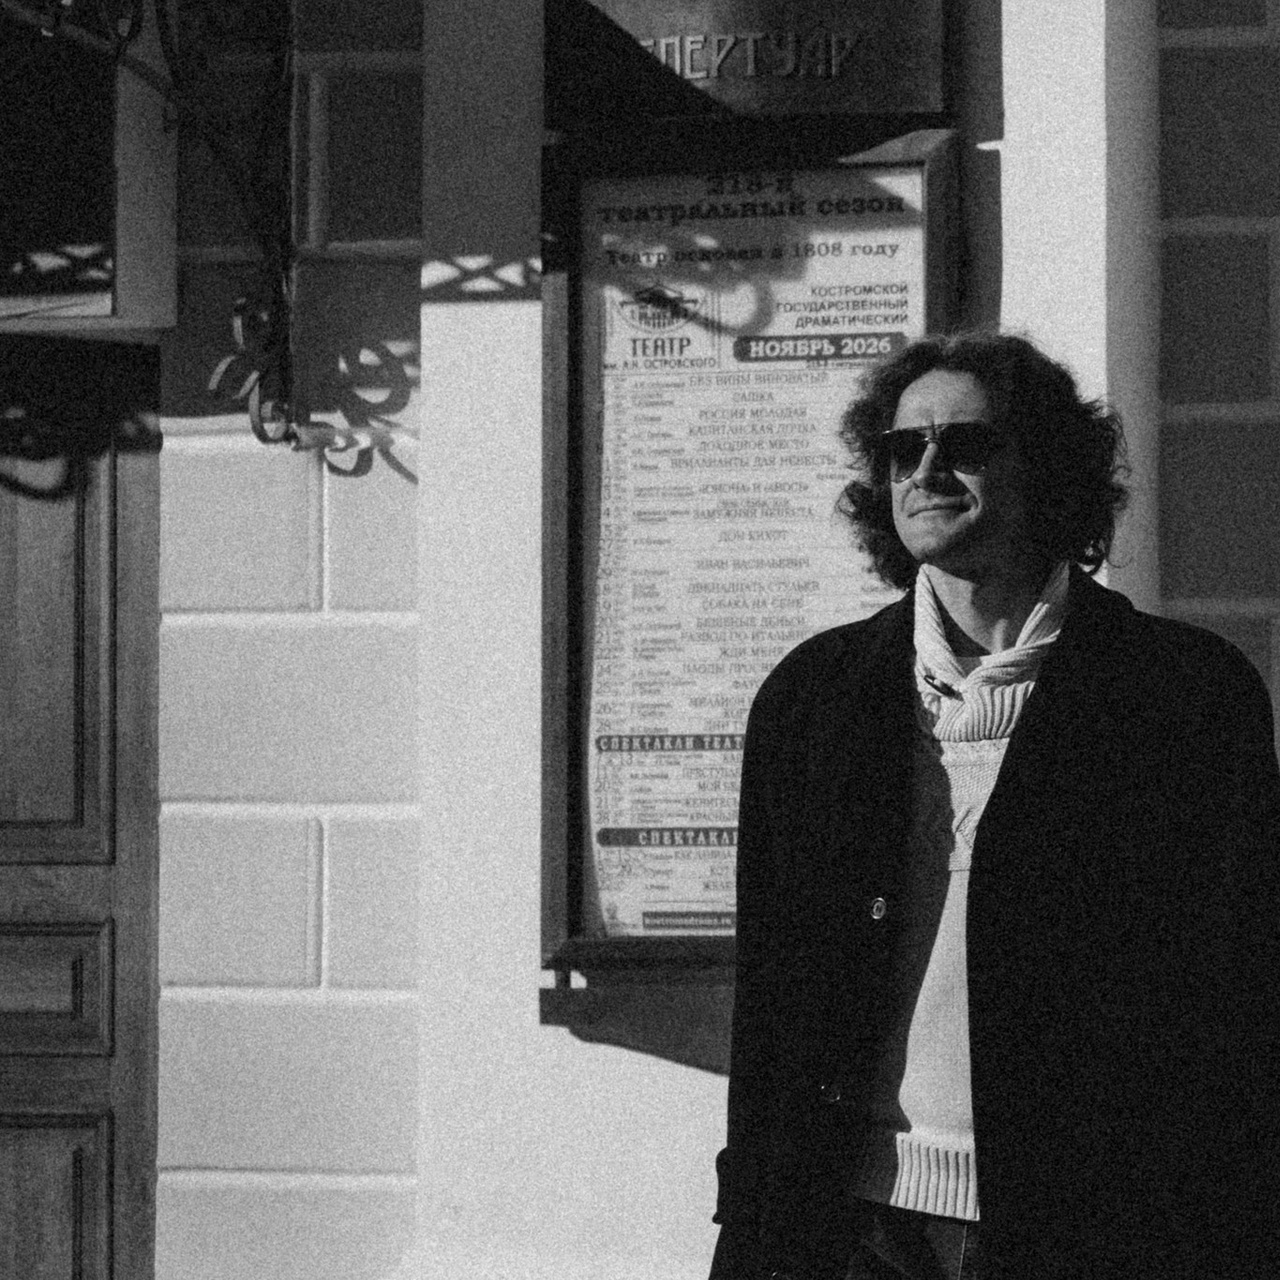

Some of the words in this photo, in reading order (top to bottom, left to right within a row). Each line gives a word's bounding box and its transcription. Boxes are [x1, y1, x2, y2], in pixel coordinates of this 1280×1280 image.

[638, 26, 860, 80] ПЕРТУАР
[817, 197, 905, 216] сезон
[791, 242, 844, 260] 1808
[850, 243, 901, 259] году
[811, 282, 909, 297] КОСТРОМСКОЙ
[776, 296, 909, 314] ГОСУДАРСТВЕННЫЙ
[795, 312, 909, 329] ДРАМАТИЧЕСКИЙ
[630, 336, 692, 357] ТЕАТР
[749, 338, 836, 358] НОЯБРЬ
[841, 337, 892, 354] 2026
[643, 357, 717, 370] ОСТРОВСКОГО
